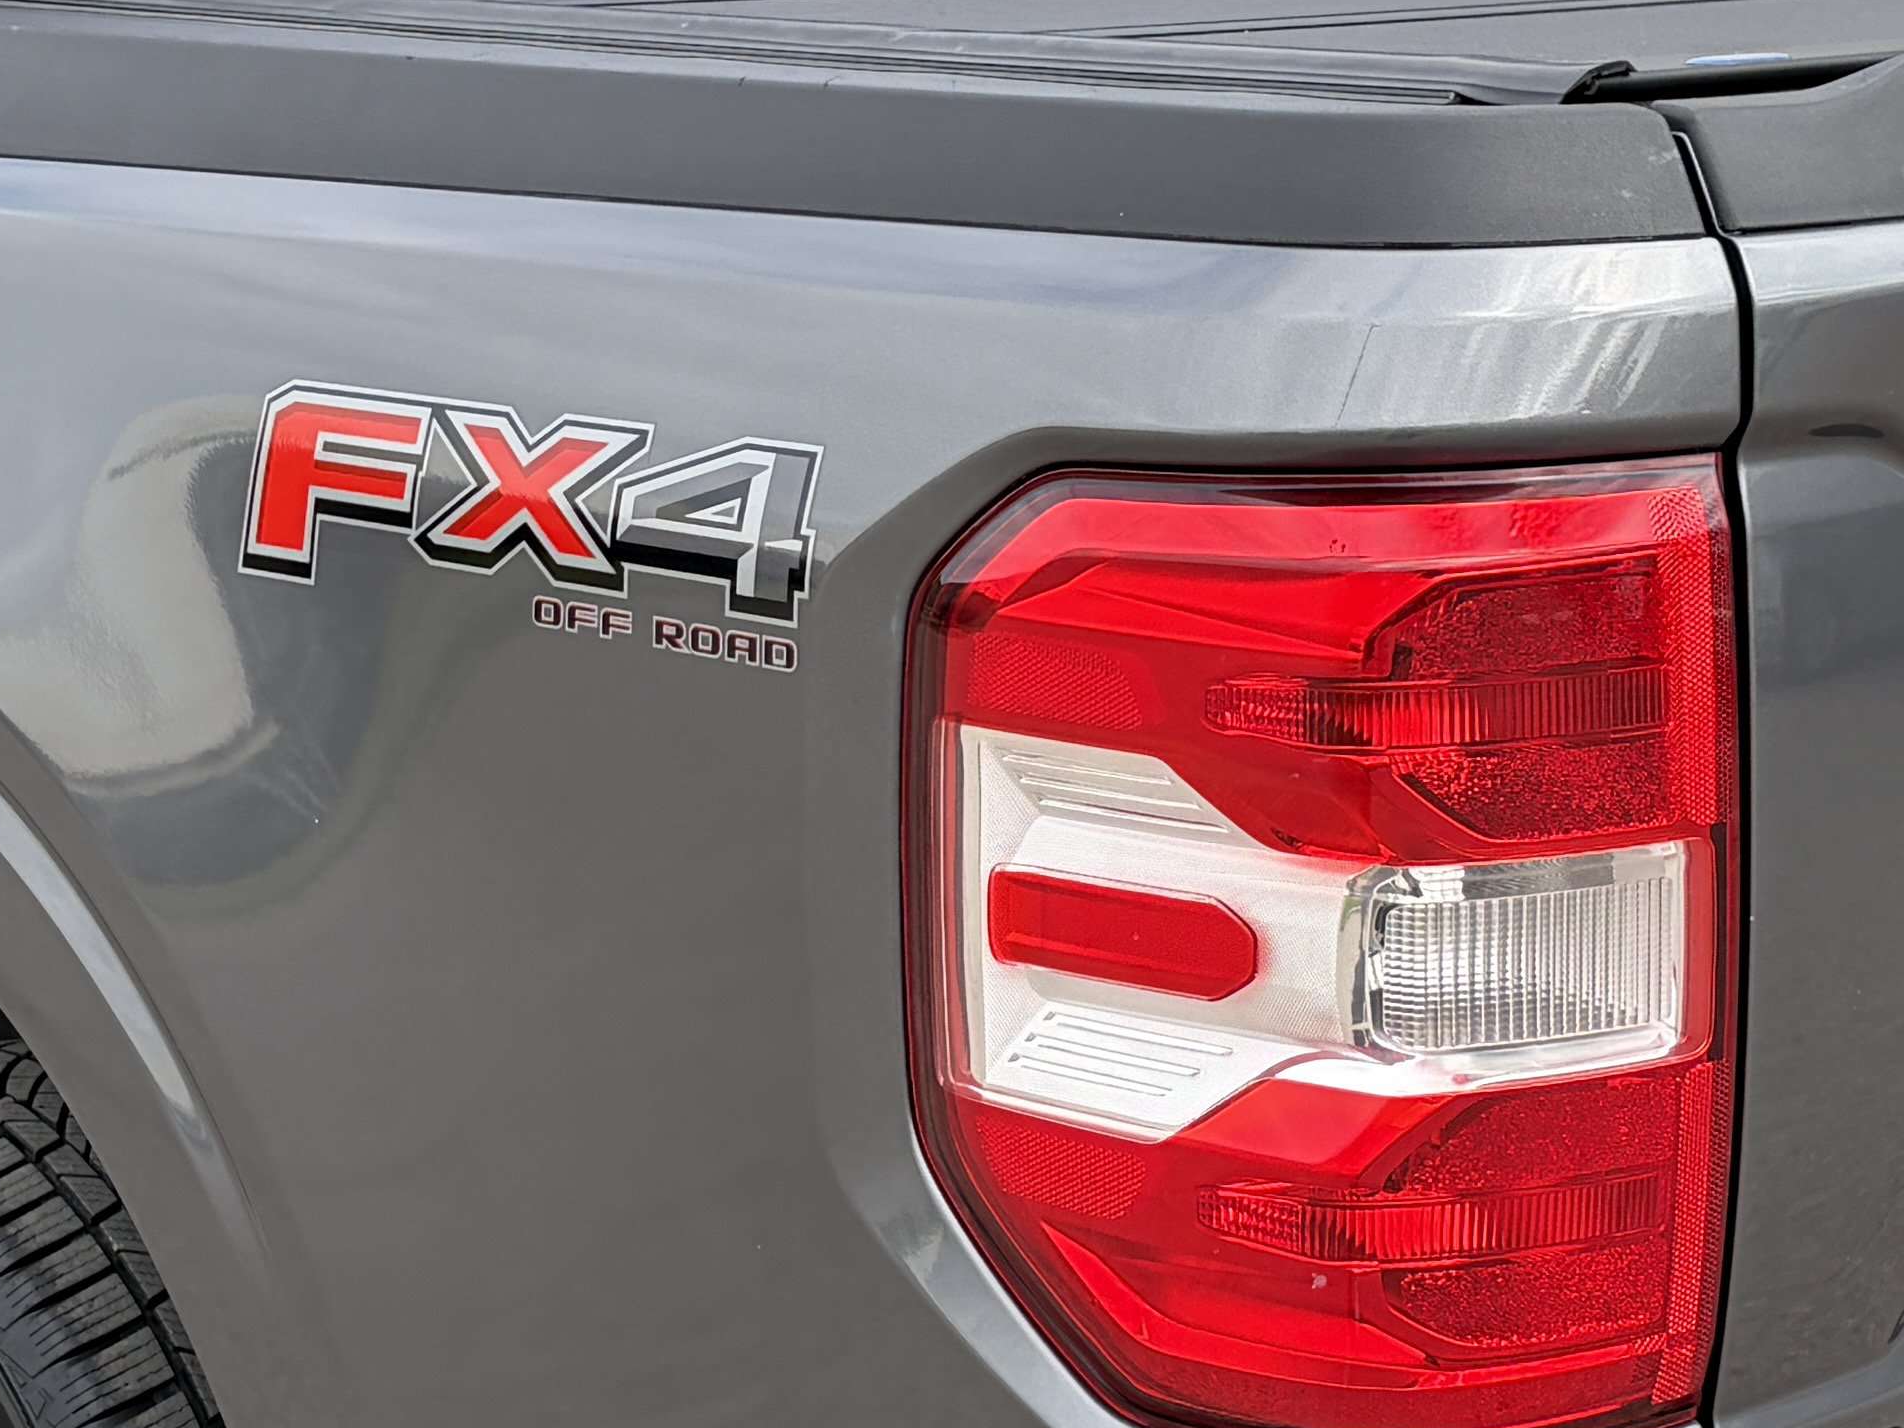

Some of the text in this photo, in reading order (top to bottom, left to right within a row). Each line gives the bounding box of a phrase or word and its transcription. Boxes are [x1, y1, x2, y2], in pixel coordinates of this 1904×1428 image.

[238, 378, 825, 629] FX4
[532, 595, 798, 673] OFF ROAD
